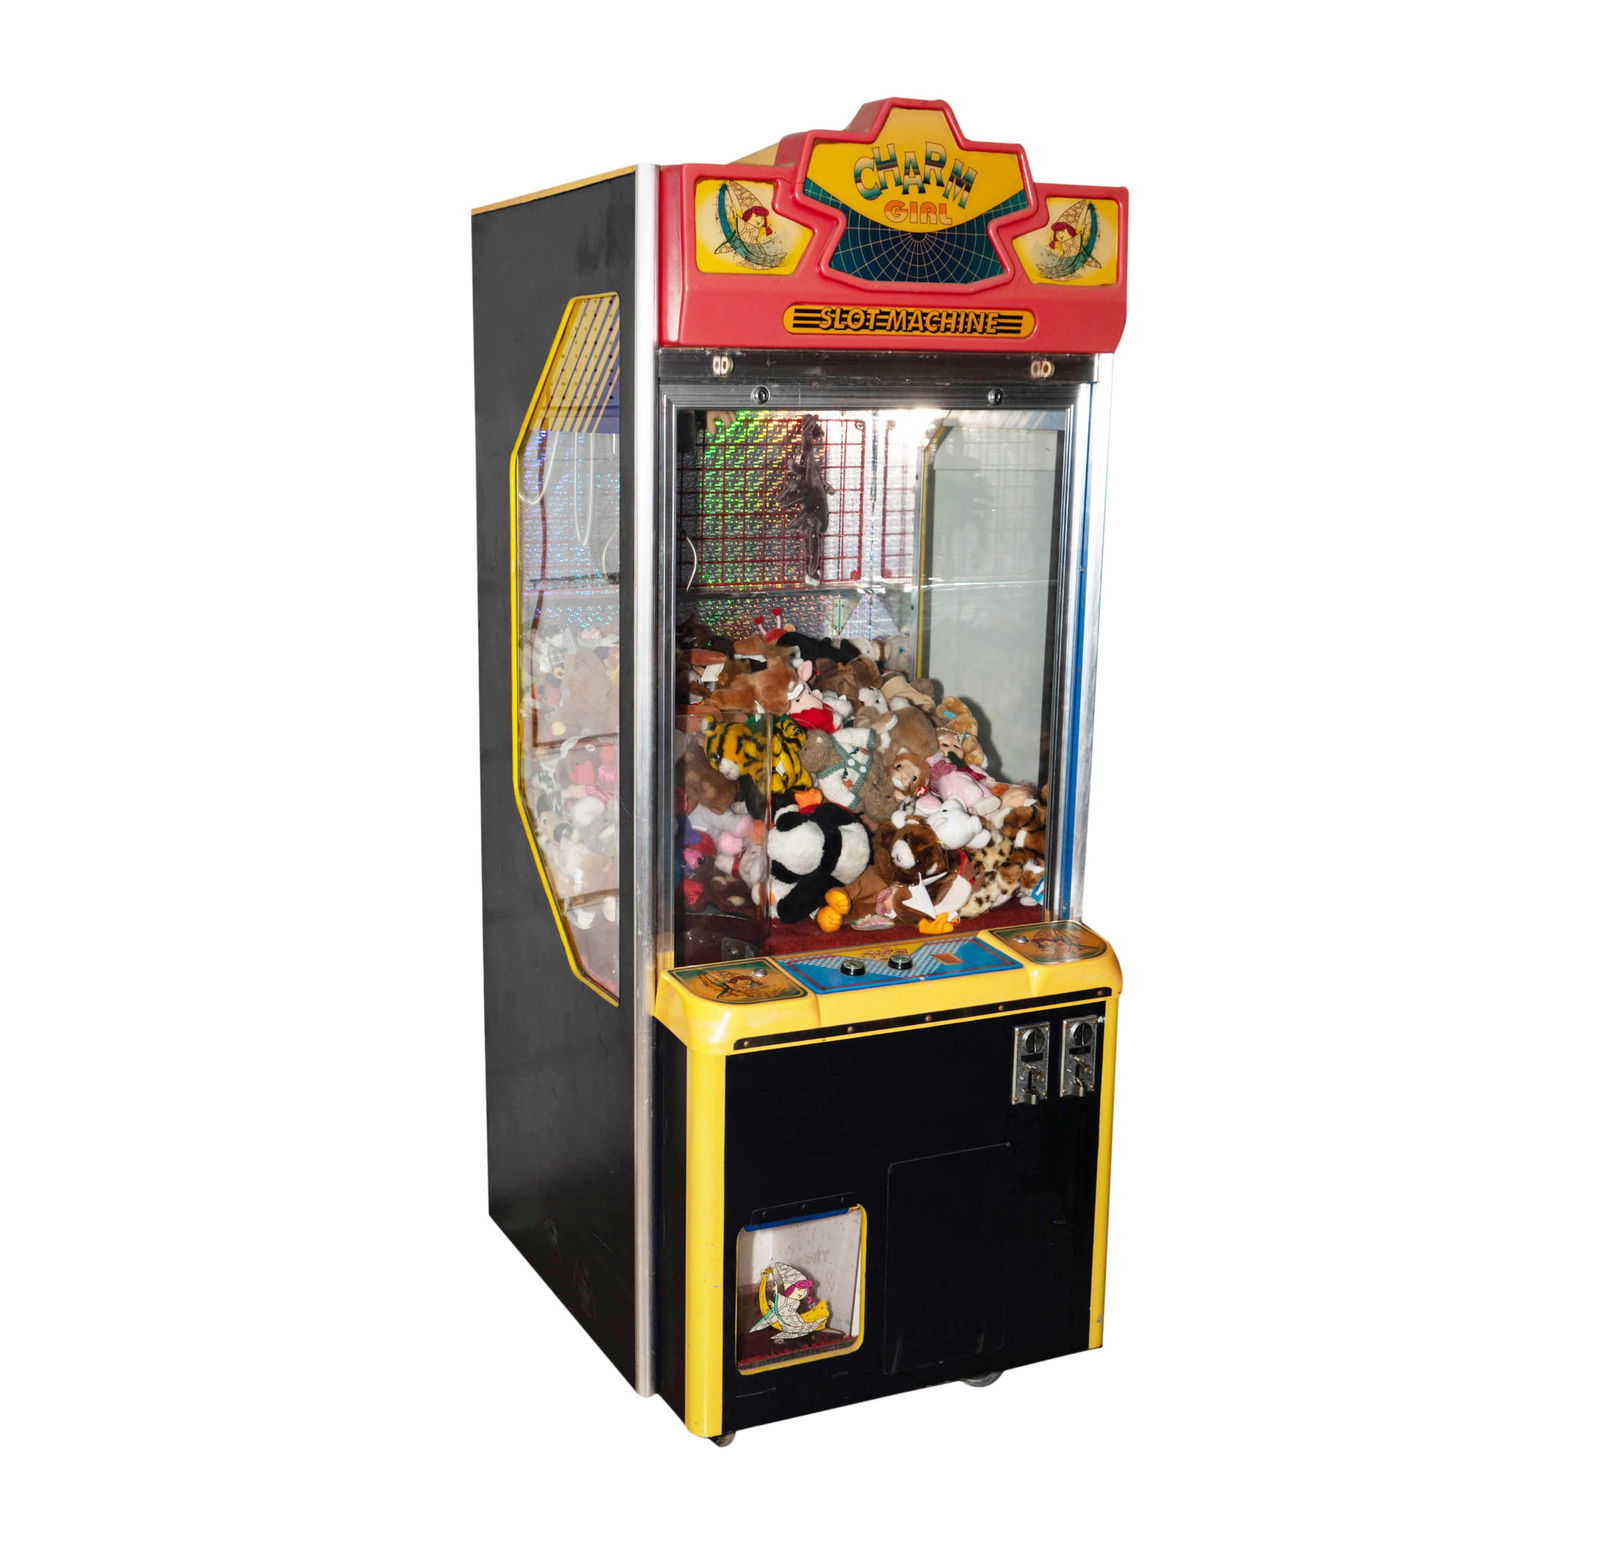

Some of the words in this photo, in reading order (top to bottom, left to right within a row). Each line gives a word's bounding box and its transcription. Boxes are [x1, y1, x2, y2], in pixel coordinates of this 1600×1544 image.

[854, 141, 977, 209] CHARM
[884, 200, 953, 225] GIRL
[819, 306, 881, 331] SLOT
[886, 309, 1000, 334] MACHINE
